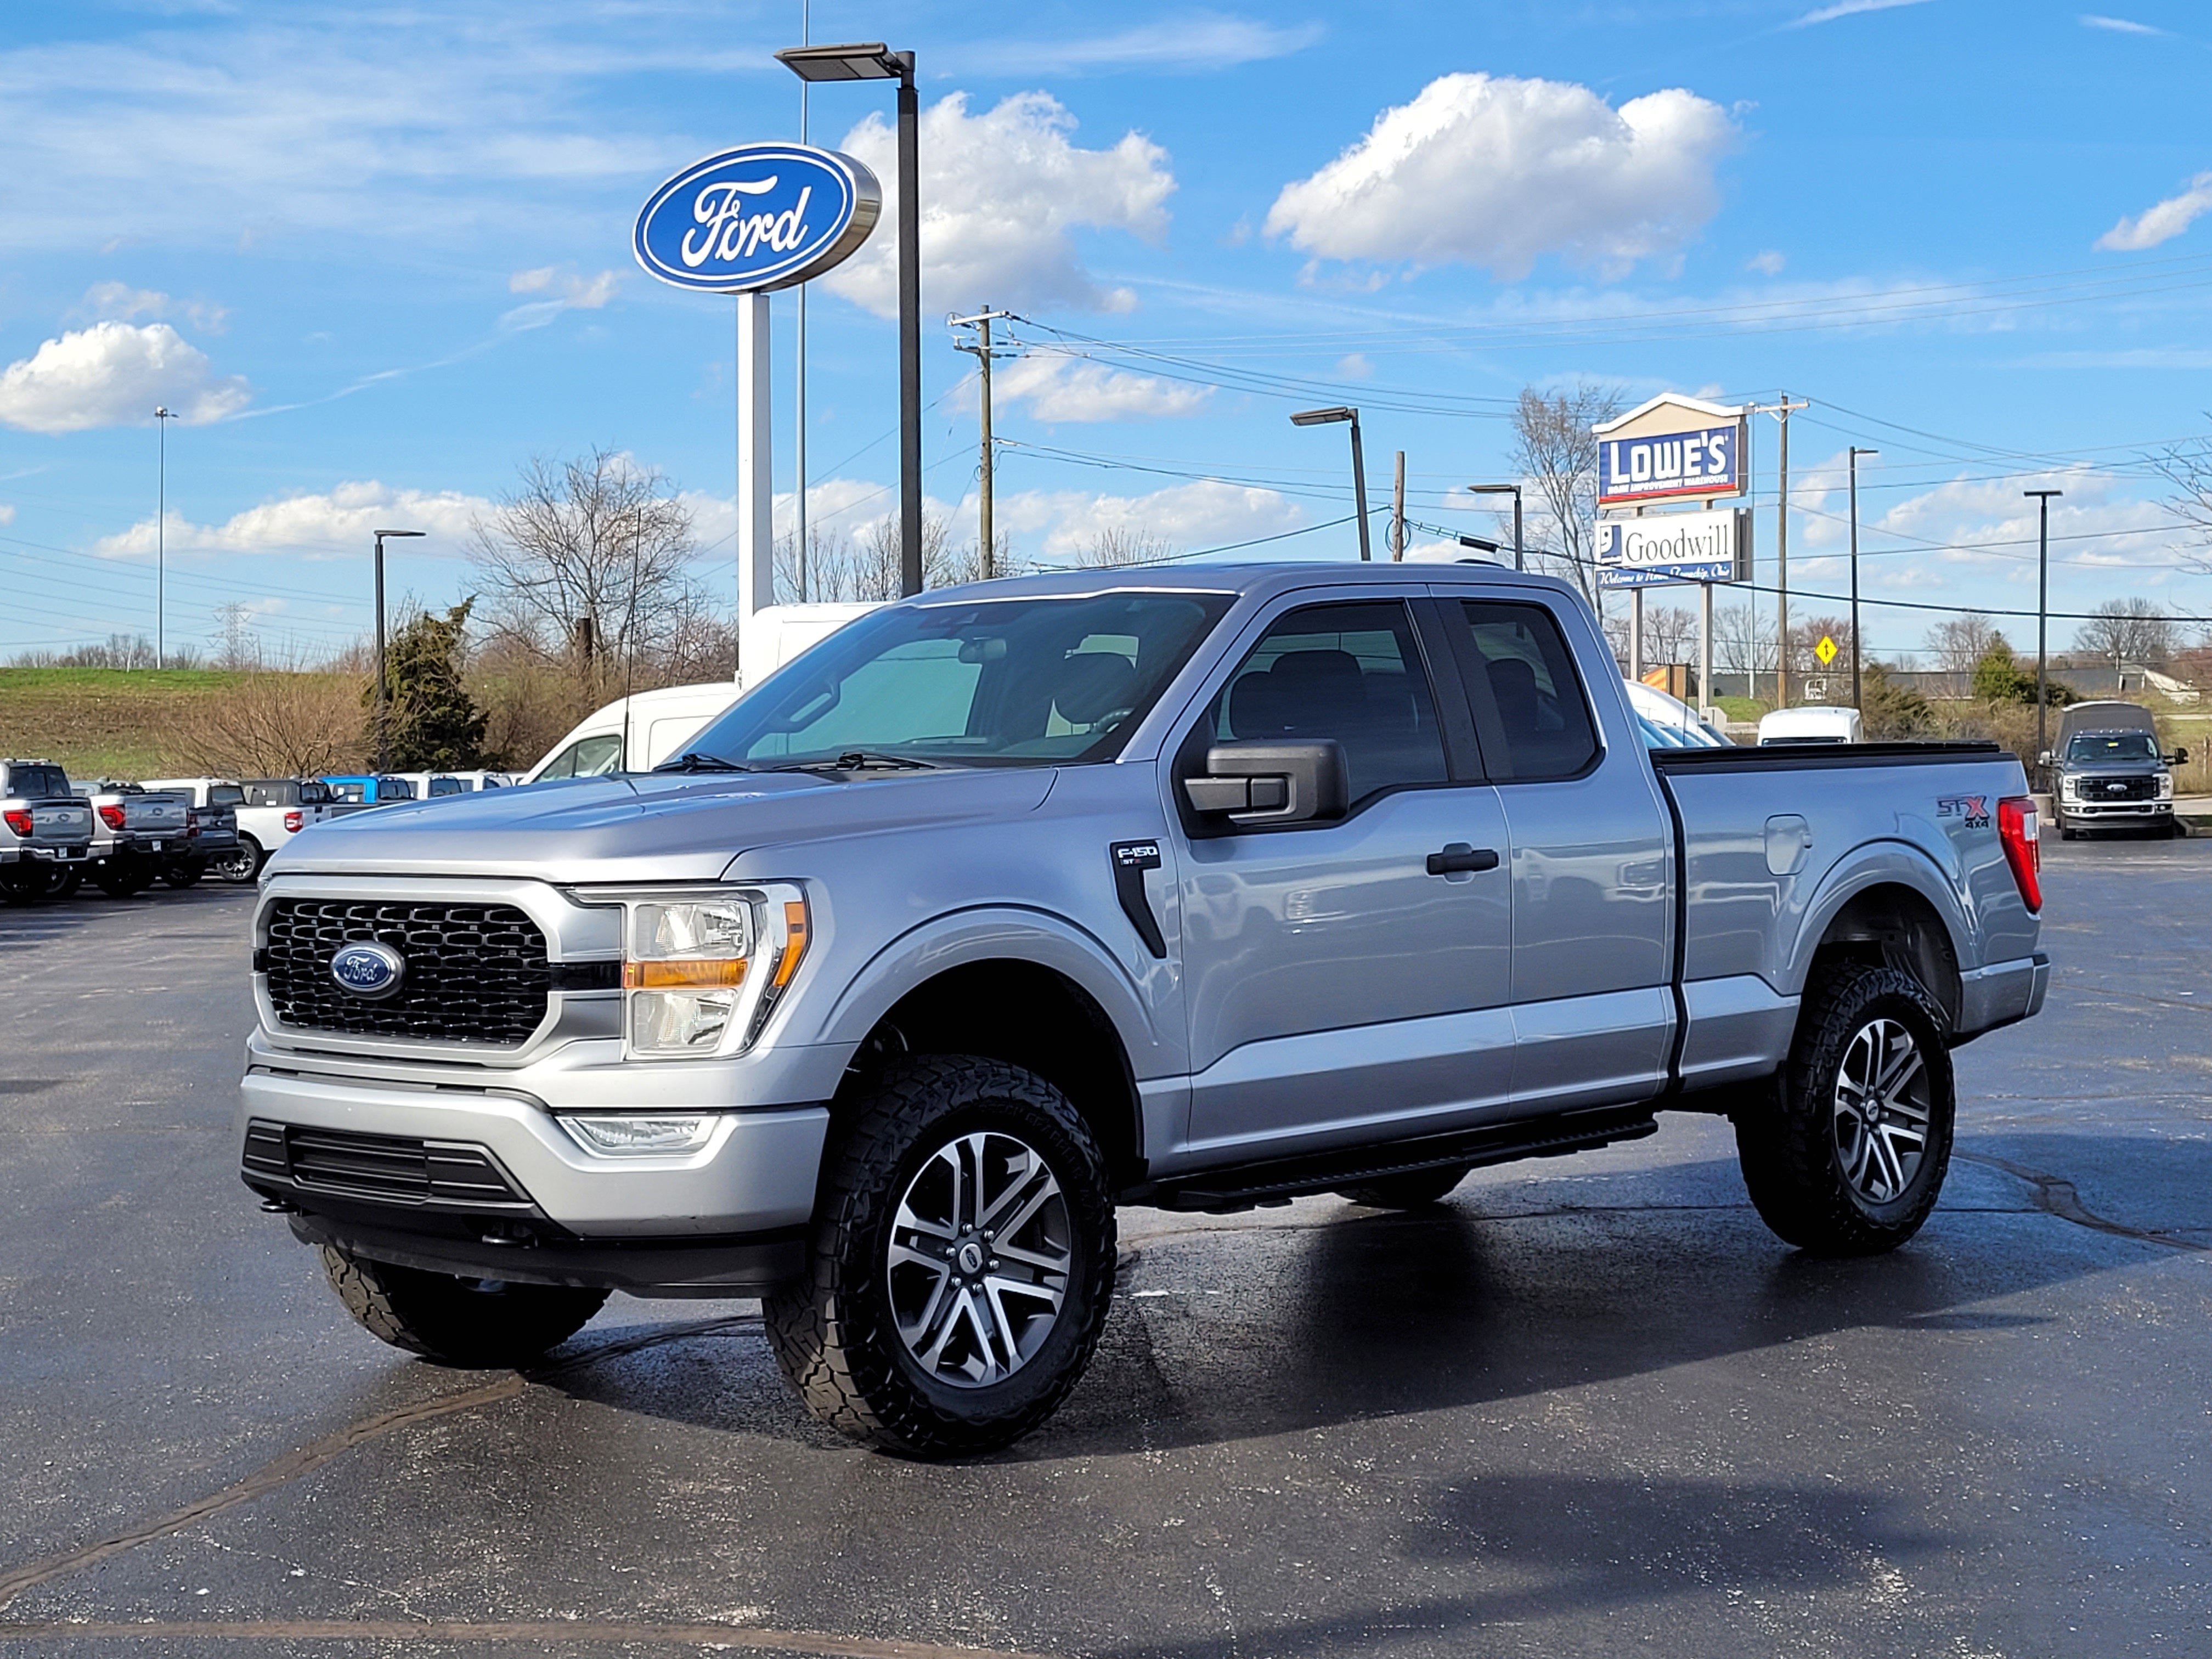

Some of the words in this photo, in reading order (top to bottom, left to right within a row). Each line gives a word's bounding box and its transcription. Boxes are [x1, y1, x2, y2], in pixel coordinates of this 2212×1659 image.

[681, 174, 812, 267] Ford
[1610, 431, 1727, 484] LOWE'S
[1626, 523, 1728, 562] Goodwill
[1937, 795, 1990, 821] STX
[1118, 846, 1158, 858] F-150
[343, 955, 378, 981] Ford
